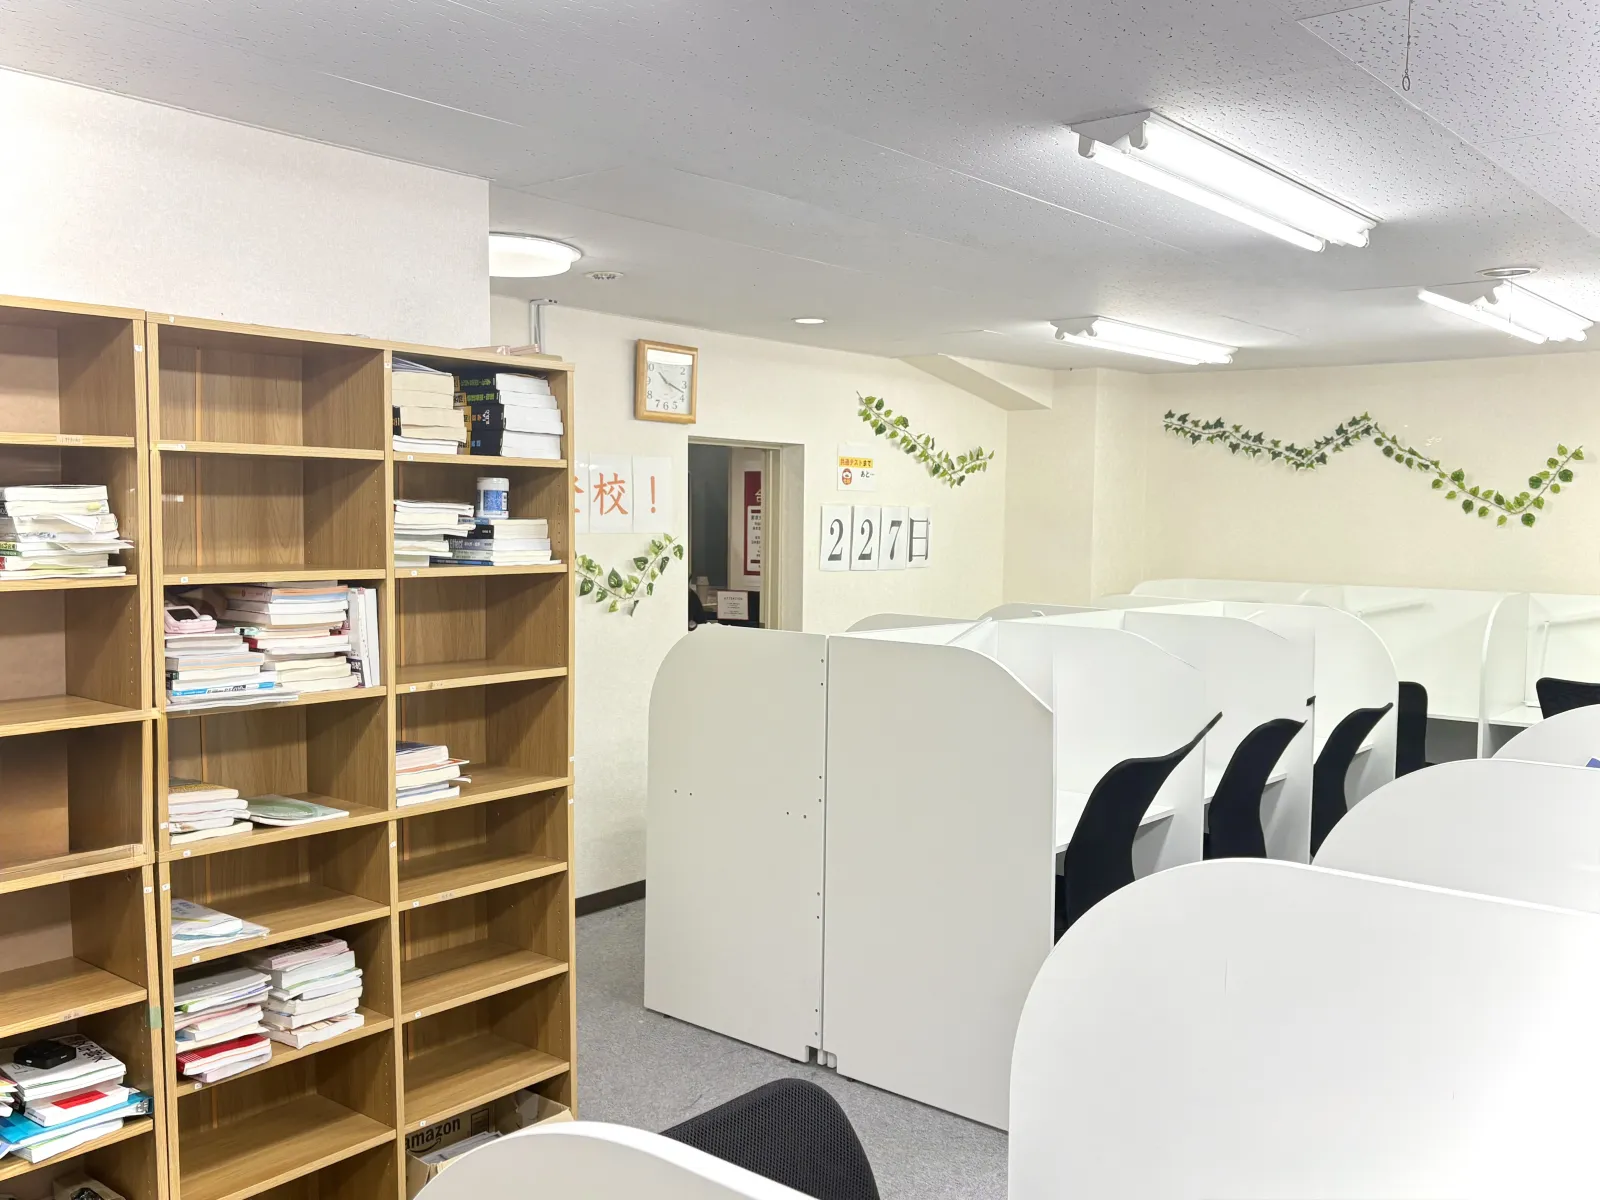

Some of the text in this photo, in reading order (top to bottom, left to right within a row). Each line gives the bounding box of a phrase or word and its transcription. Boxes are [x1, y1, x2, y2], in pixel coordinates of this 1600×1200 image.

[680, 366, 686, 376] 2
[682, 380, 687, 390] 3
[646, 390, 652, 400] 8
[655, 400, 660, 408] 7
[663, 402, 668, 410] 6
[672, 400, 678, 410] 5
